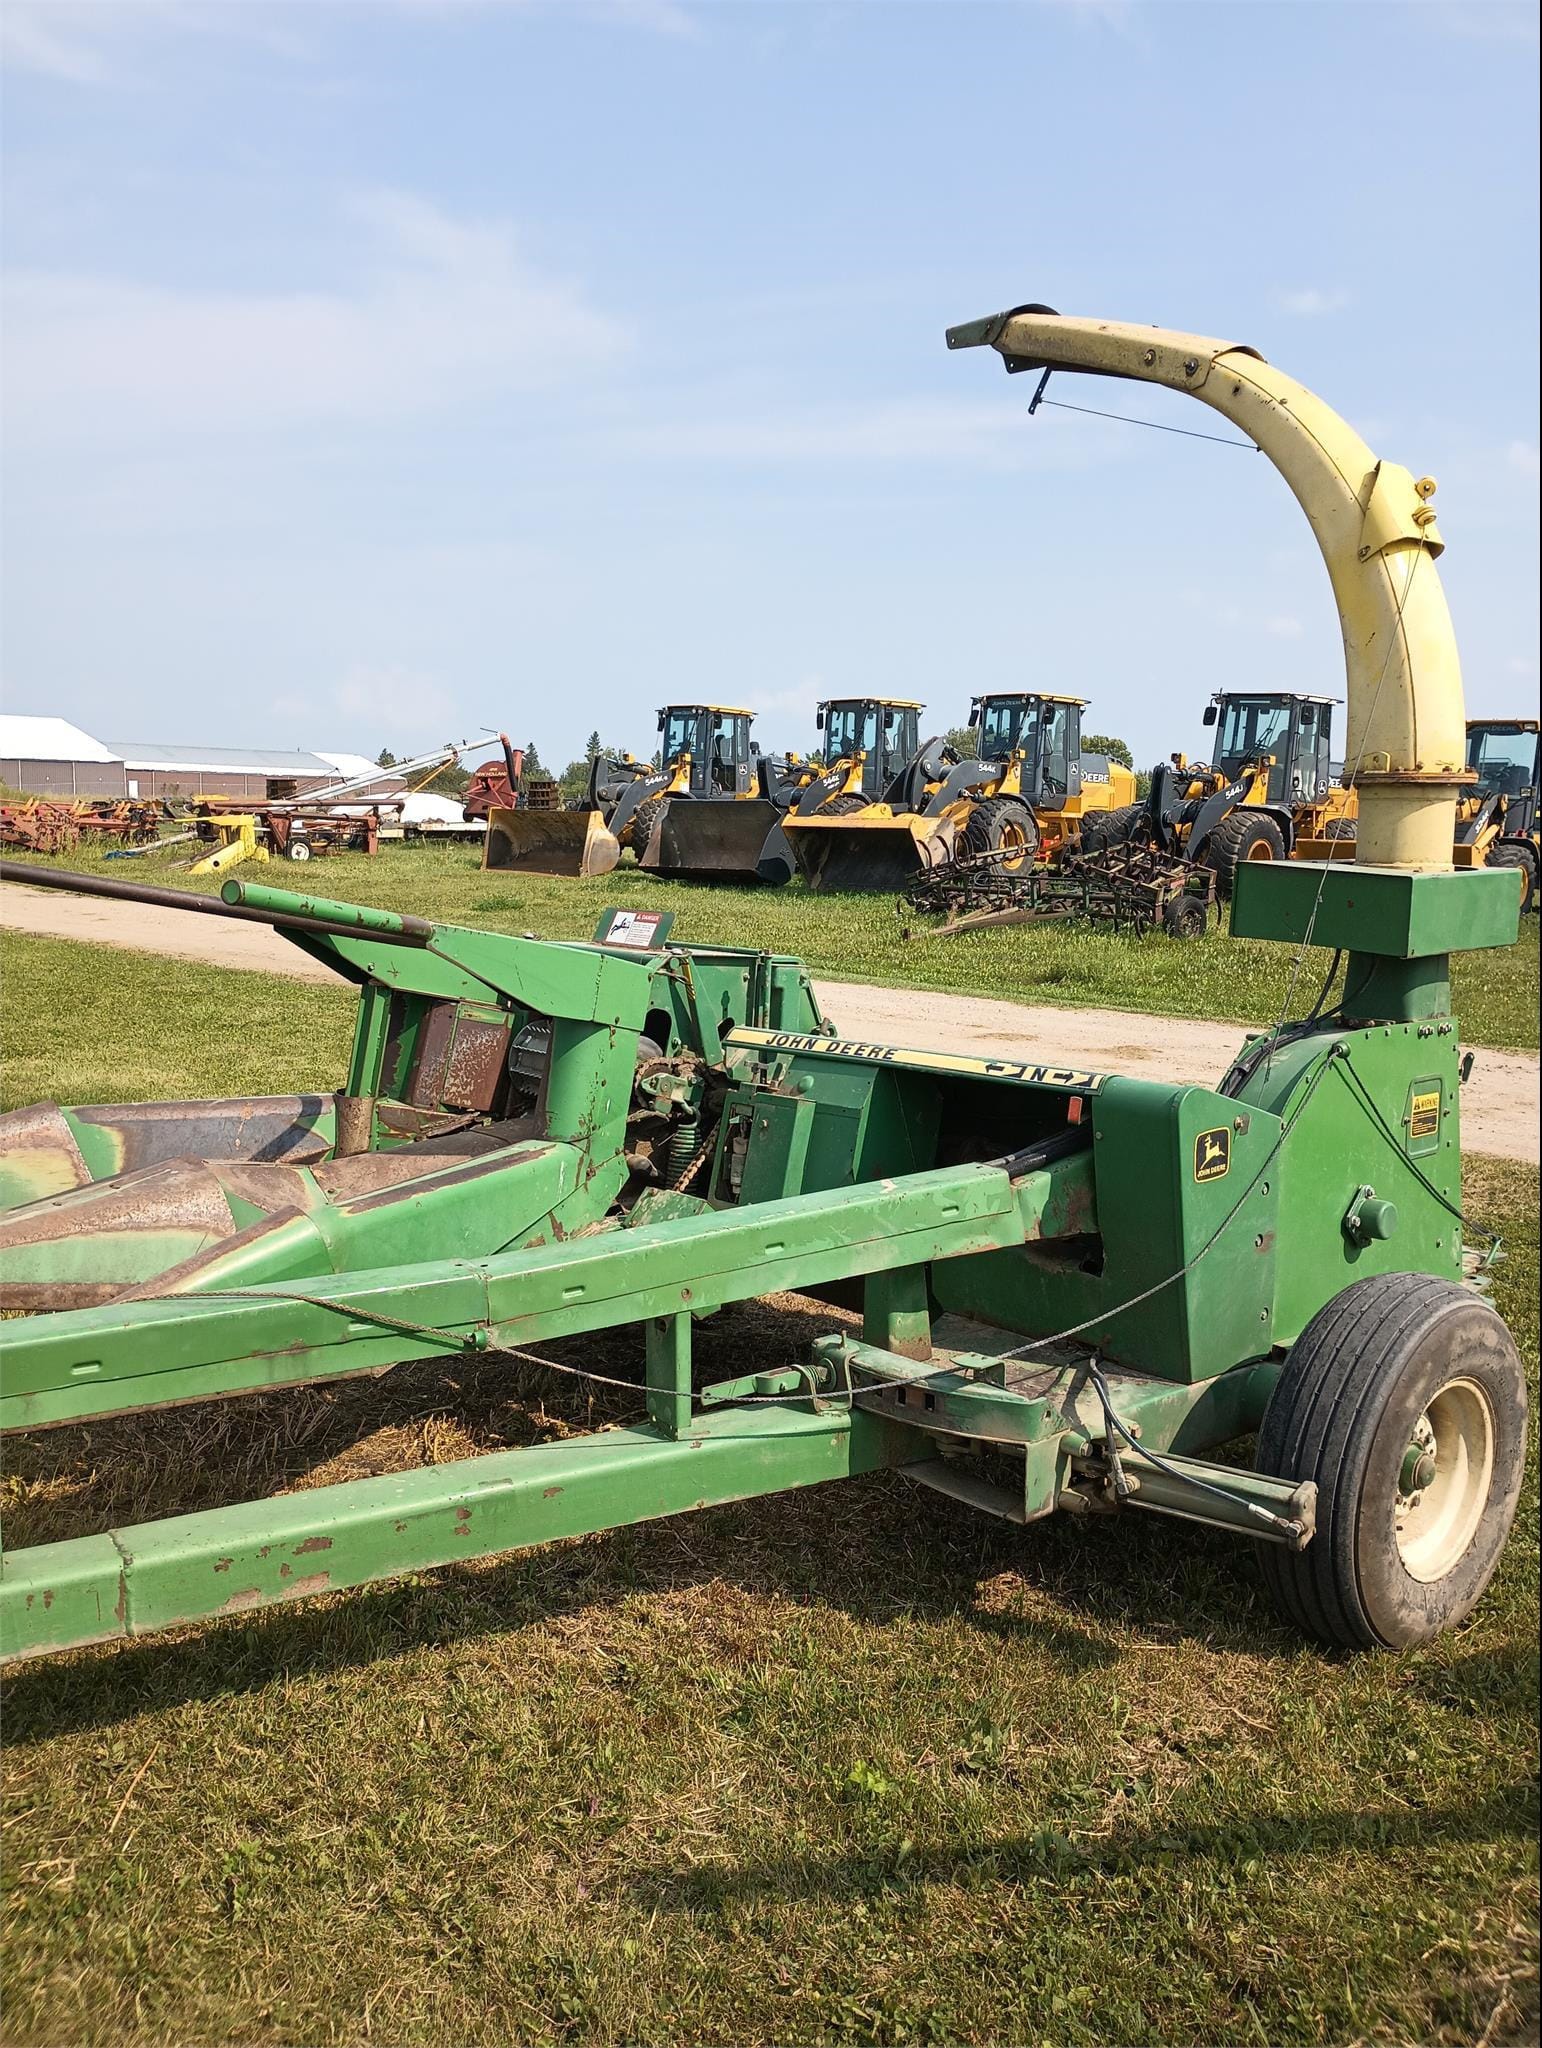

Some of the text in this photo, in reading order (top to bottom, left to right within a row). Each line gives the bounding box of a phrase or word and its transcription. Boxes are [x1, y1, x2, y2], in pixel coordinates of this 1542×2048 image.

[978, 763, 997, 773] 544K
[1081, 769, 1109, 783] DEERE
[1225, 784, 1244, 800] 544J
[766, 1034, 900, 1060] JOHN DEERE
[1197, 1163, 1226, 1178] JOHN DEERE
